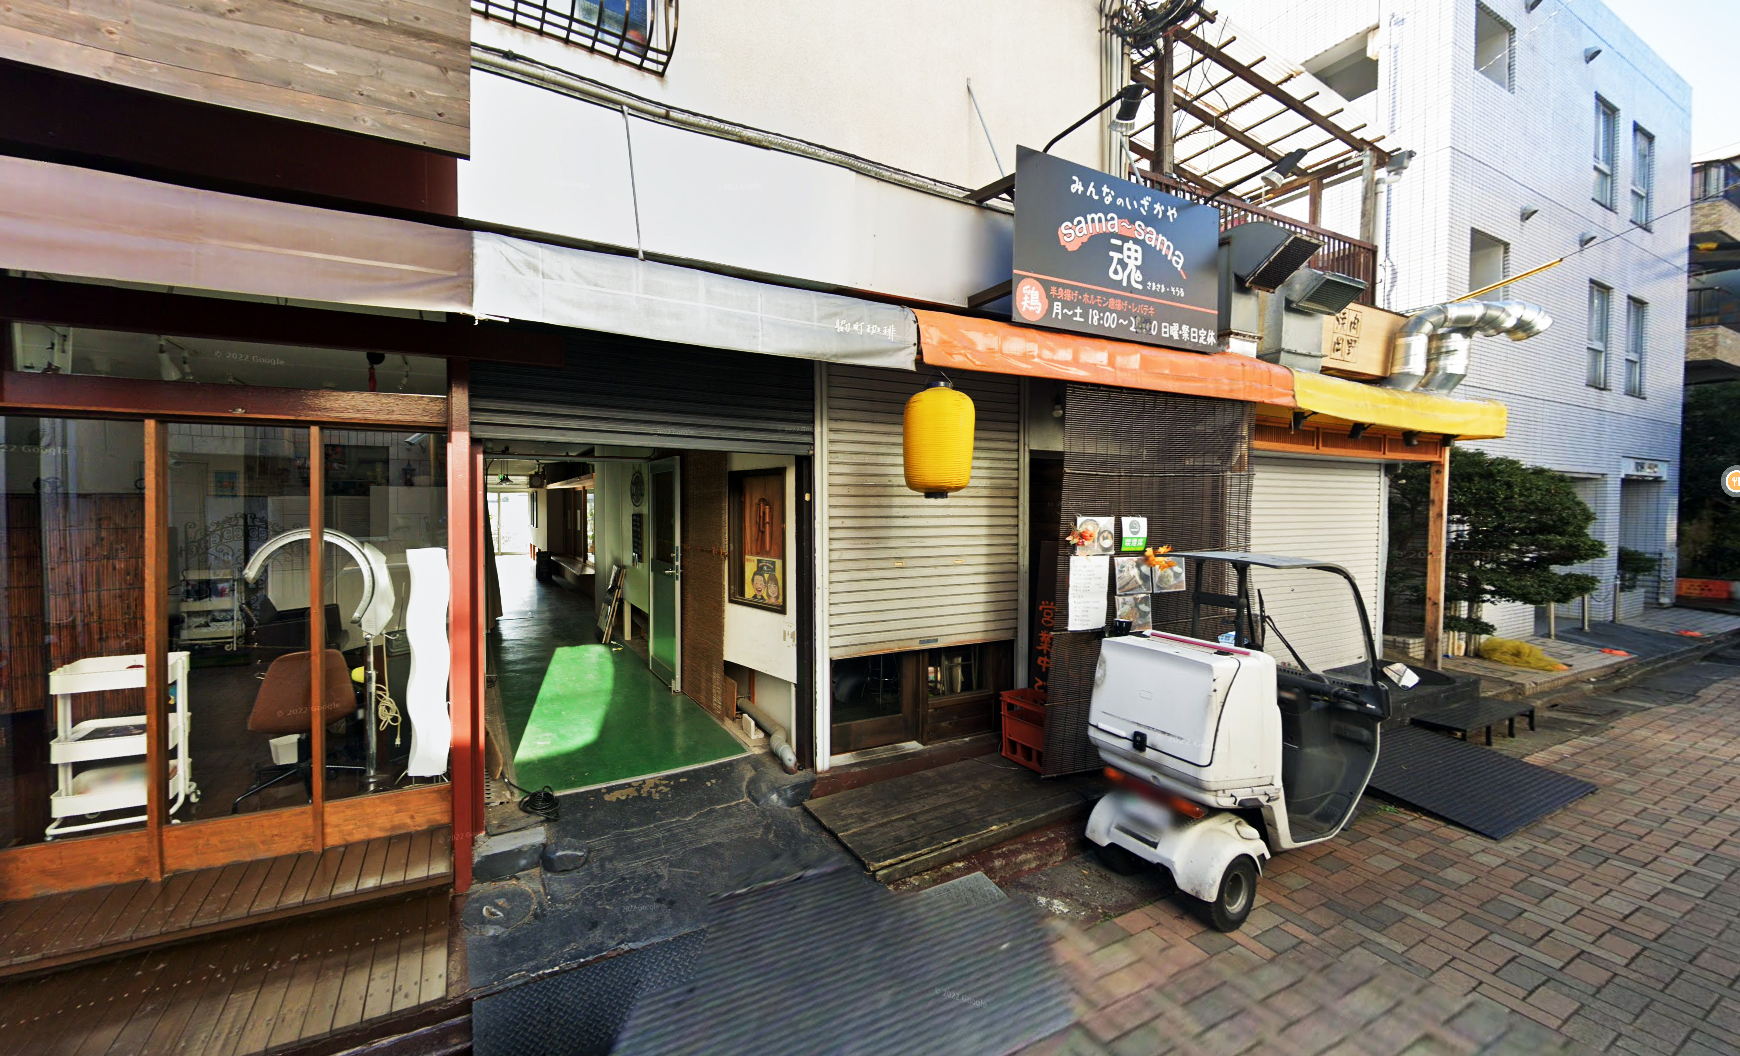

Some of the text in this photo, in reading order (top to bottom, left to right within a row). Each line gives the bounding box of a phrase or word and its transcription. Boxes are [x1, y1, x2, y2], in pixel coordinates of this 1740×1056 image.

[1070, 175, 1178, 223] みんなのいざかや
[1108, 238, 1143, 290] 魂
[1021, 285, 1042, 314] 鶏
